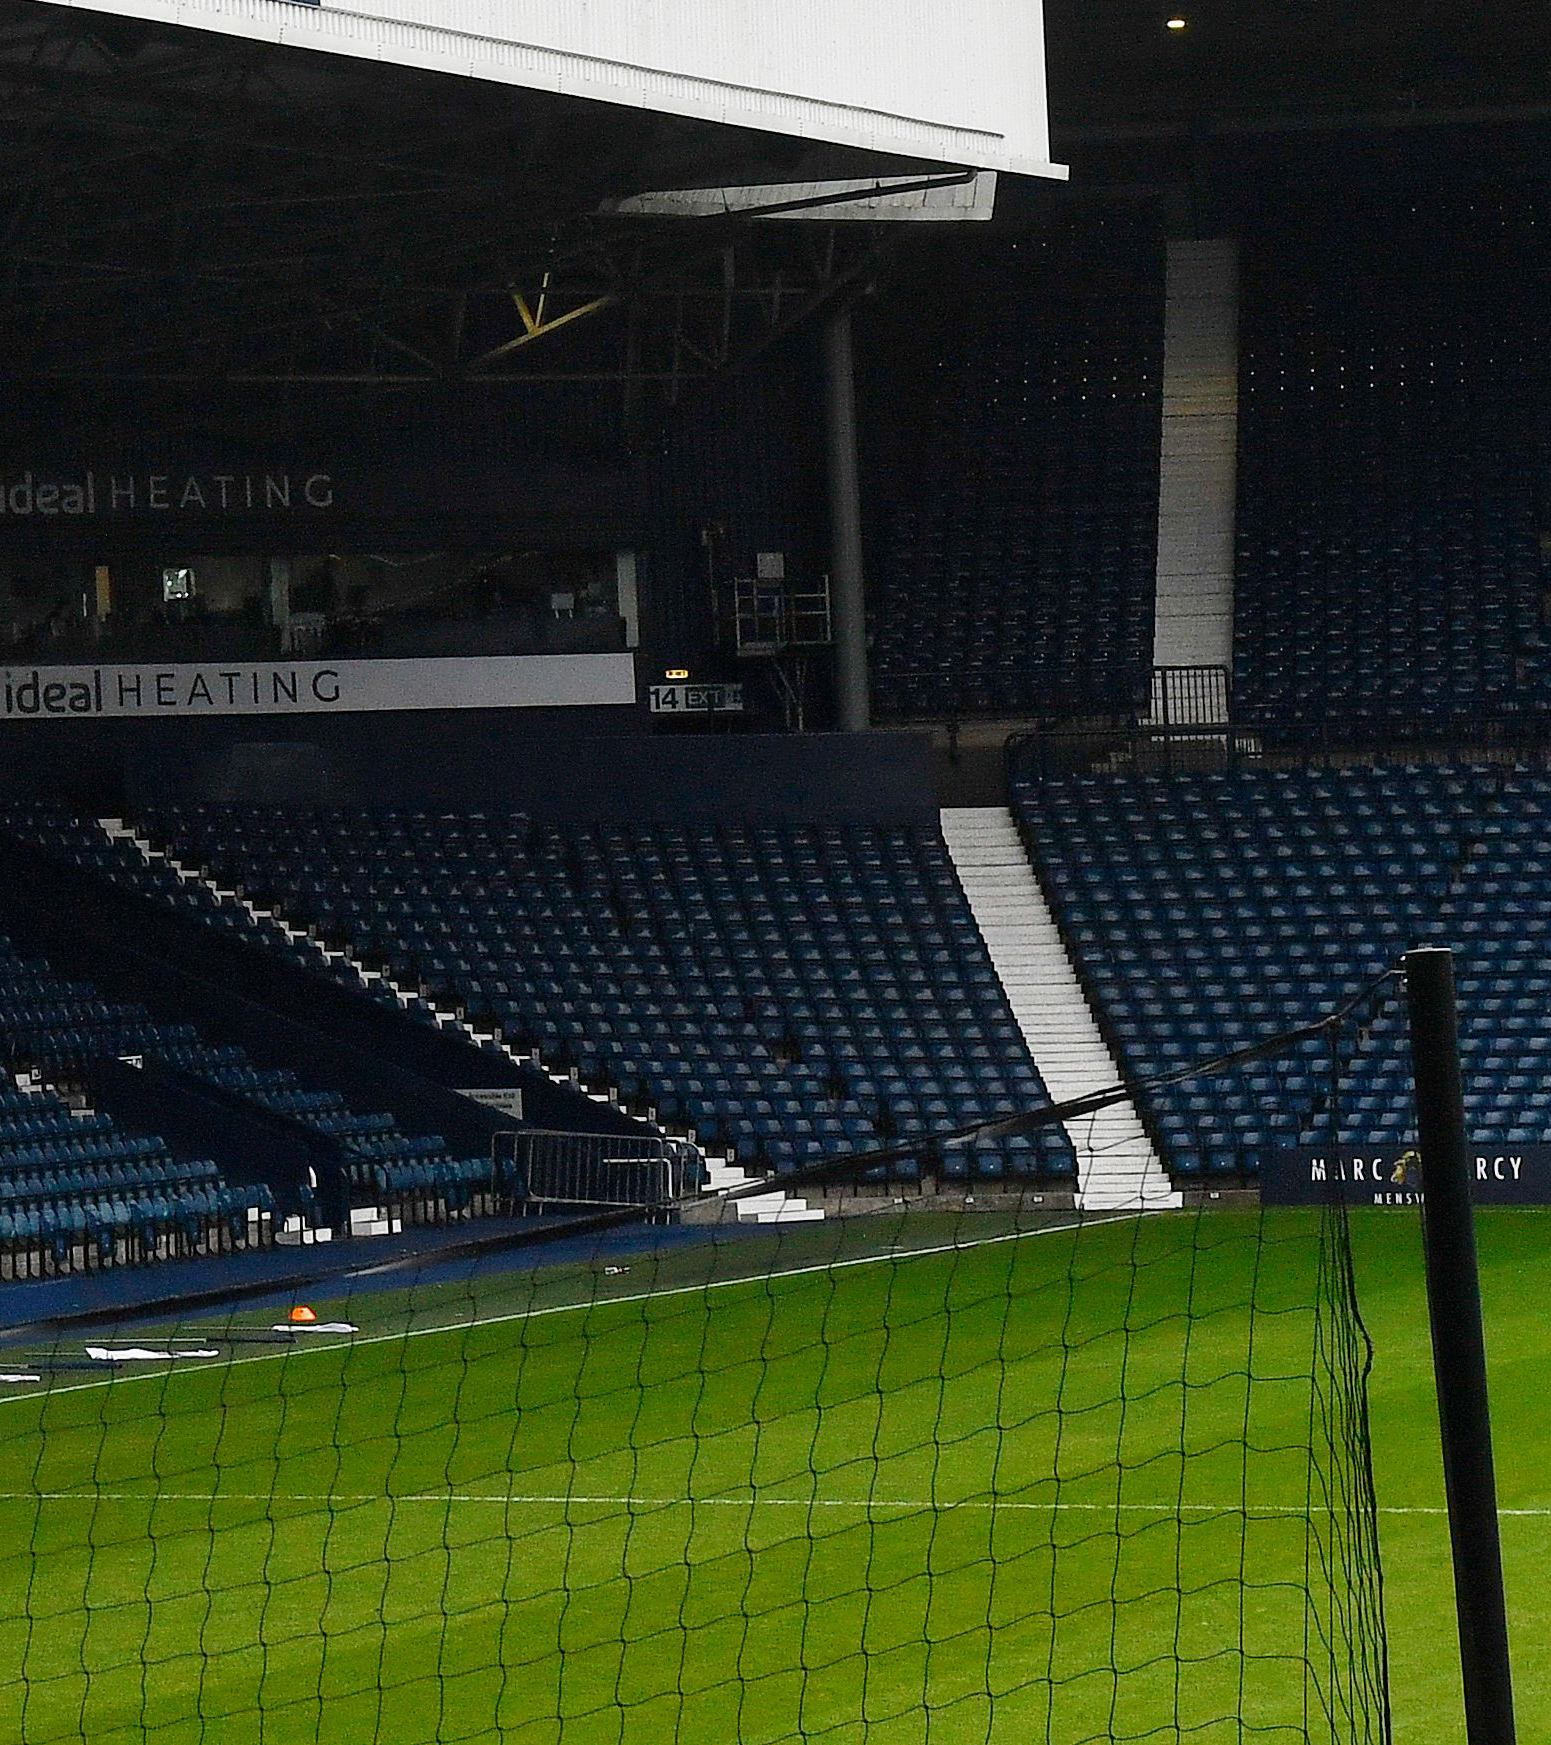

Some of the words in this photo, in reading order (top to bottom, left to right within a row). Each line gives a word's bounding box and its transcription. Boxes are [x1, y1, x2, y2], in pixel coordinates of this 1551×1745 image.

[110, 474, 336, 509] HEATING
[3, 669, 102, 716] ideal
[116, 668, 342, 708] HEATING
[648, 687, 679, 709] 14
[687, 690, 721, 705] EXT
